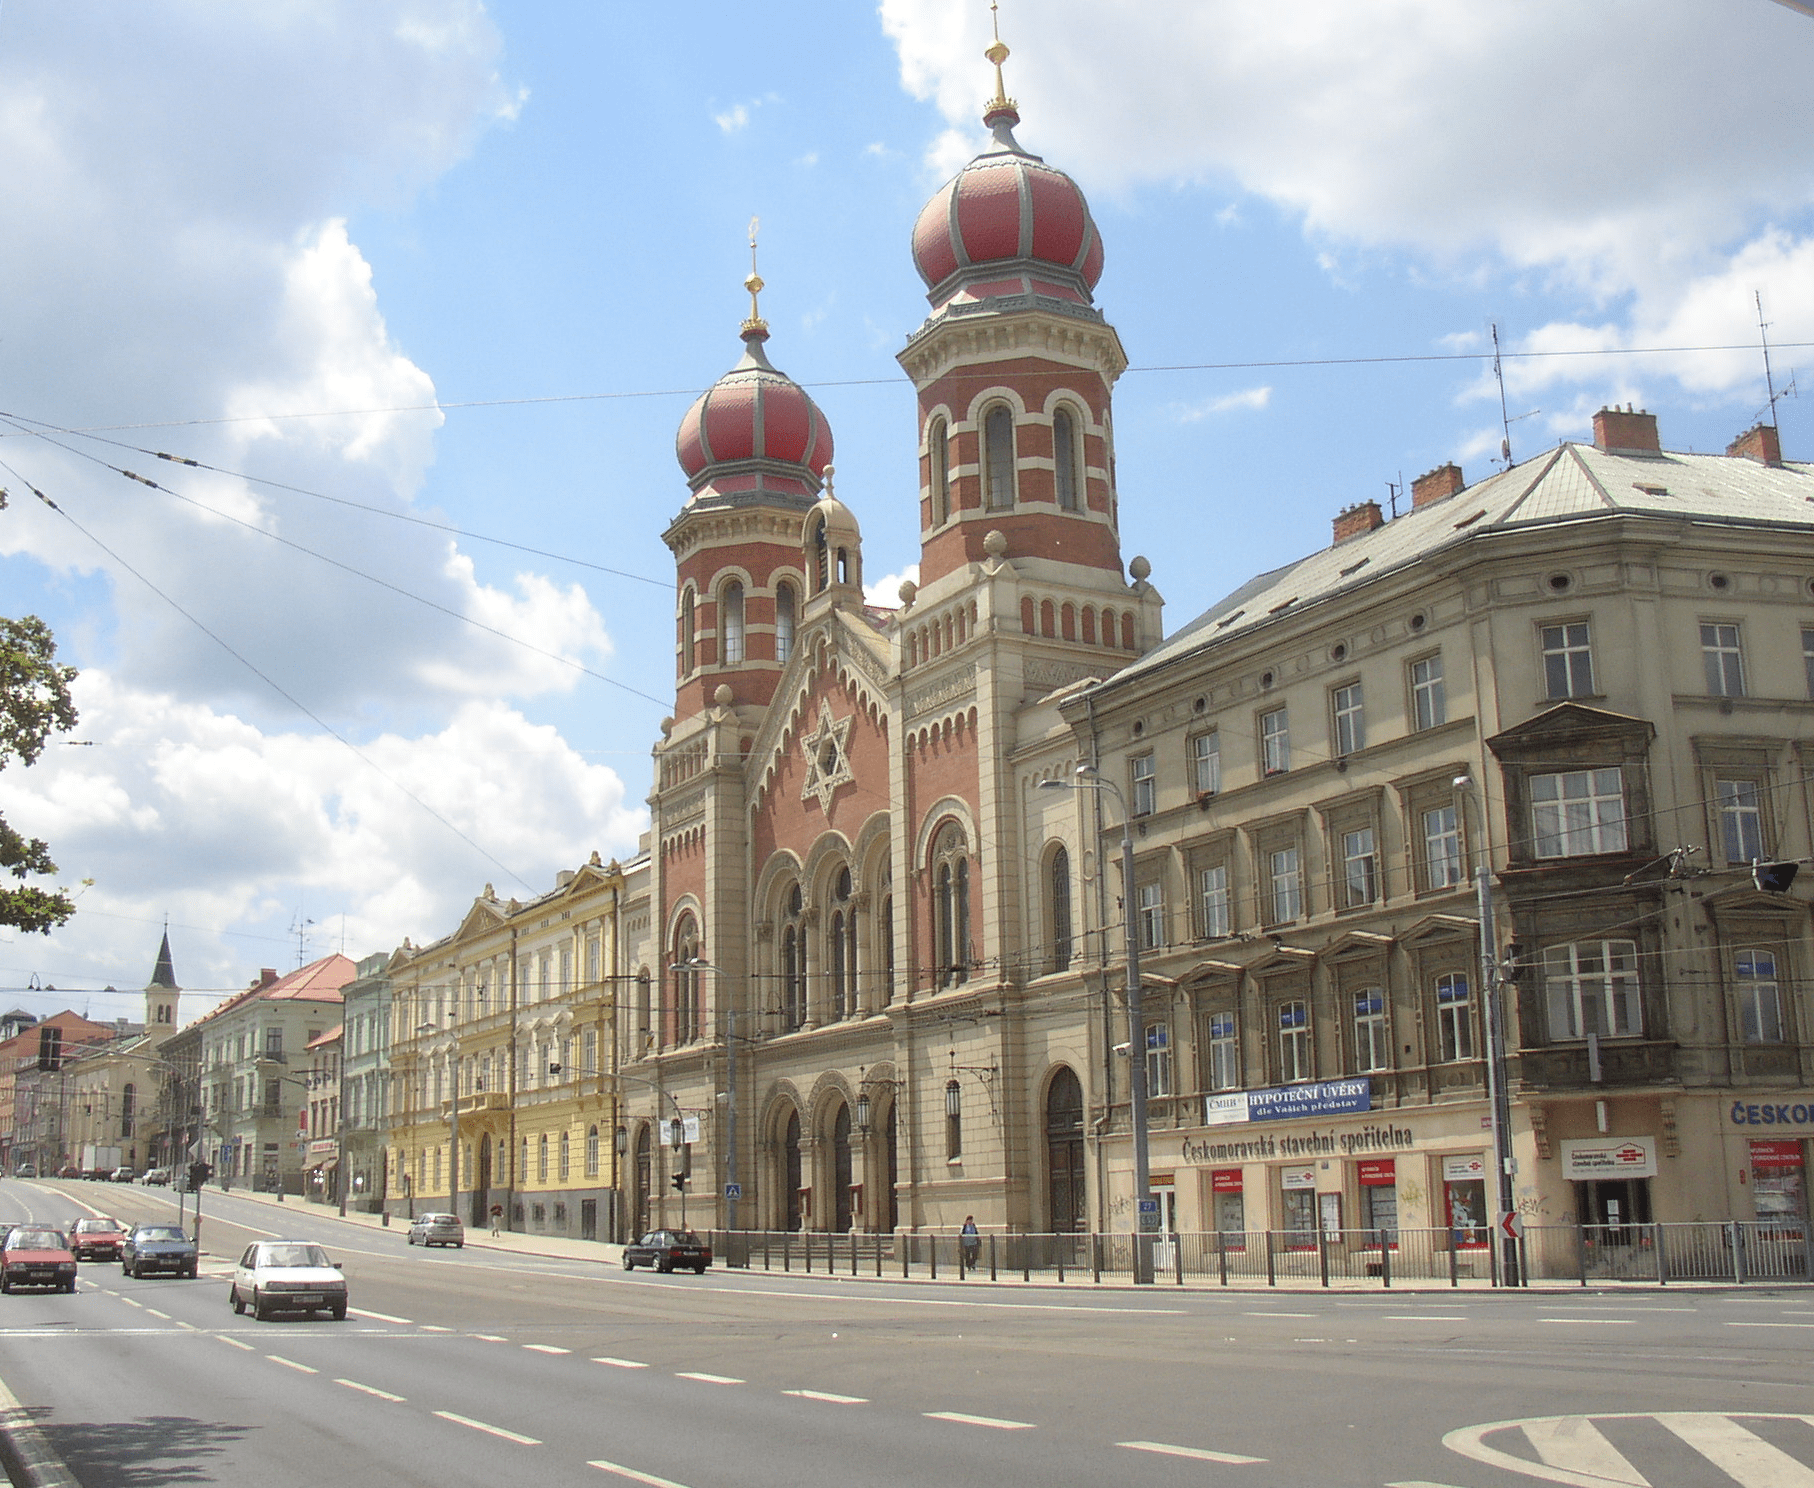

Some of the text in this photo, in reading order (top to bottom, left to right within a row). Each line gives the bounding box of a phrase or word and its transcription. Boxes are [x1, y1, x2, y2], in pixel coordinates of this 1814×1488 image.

[1249, 1082, 1365, 1106] HYPOTEČNÍ ÚVĚRY
[1256, 1107, 1272, 1116] dle
[1731, 1101, 1814, 1125] ČESKO
[1182, 1124, 1412, 1162] Českomoravská stavební spořitelna
